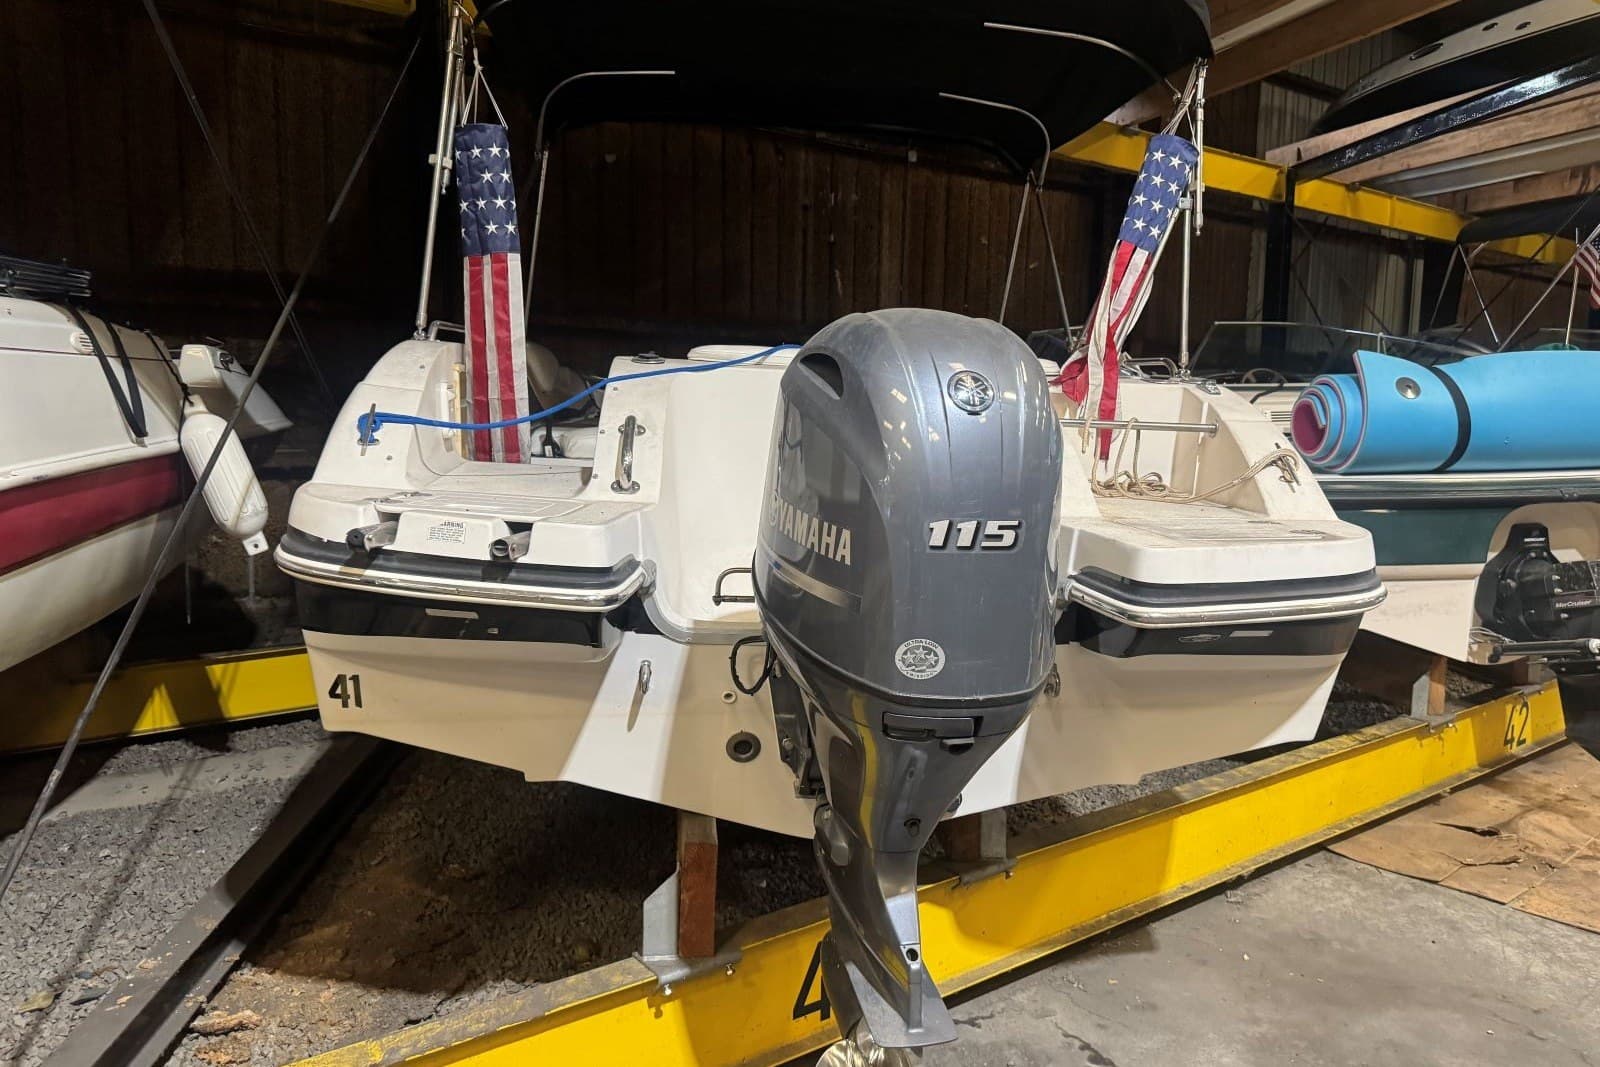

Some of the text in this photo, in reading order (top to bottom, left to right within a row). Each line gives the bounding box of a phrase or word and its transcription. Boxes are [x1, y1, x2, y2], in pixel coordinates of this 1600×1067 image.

[778, 502, 851, 566] YAMAHA
[928, 519, 1021, 548] 115
[328, 673, 363, 709] 41
[1503, 701, 1530, 750] 42
